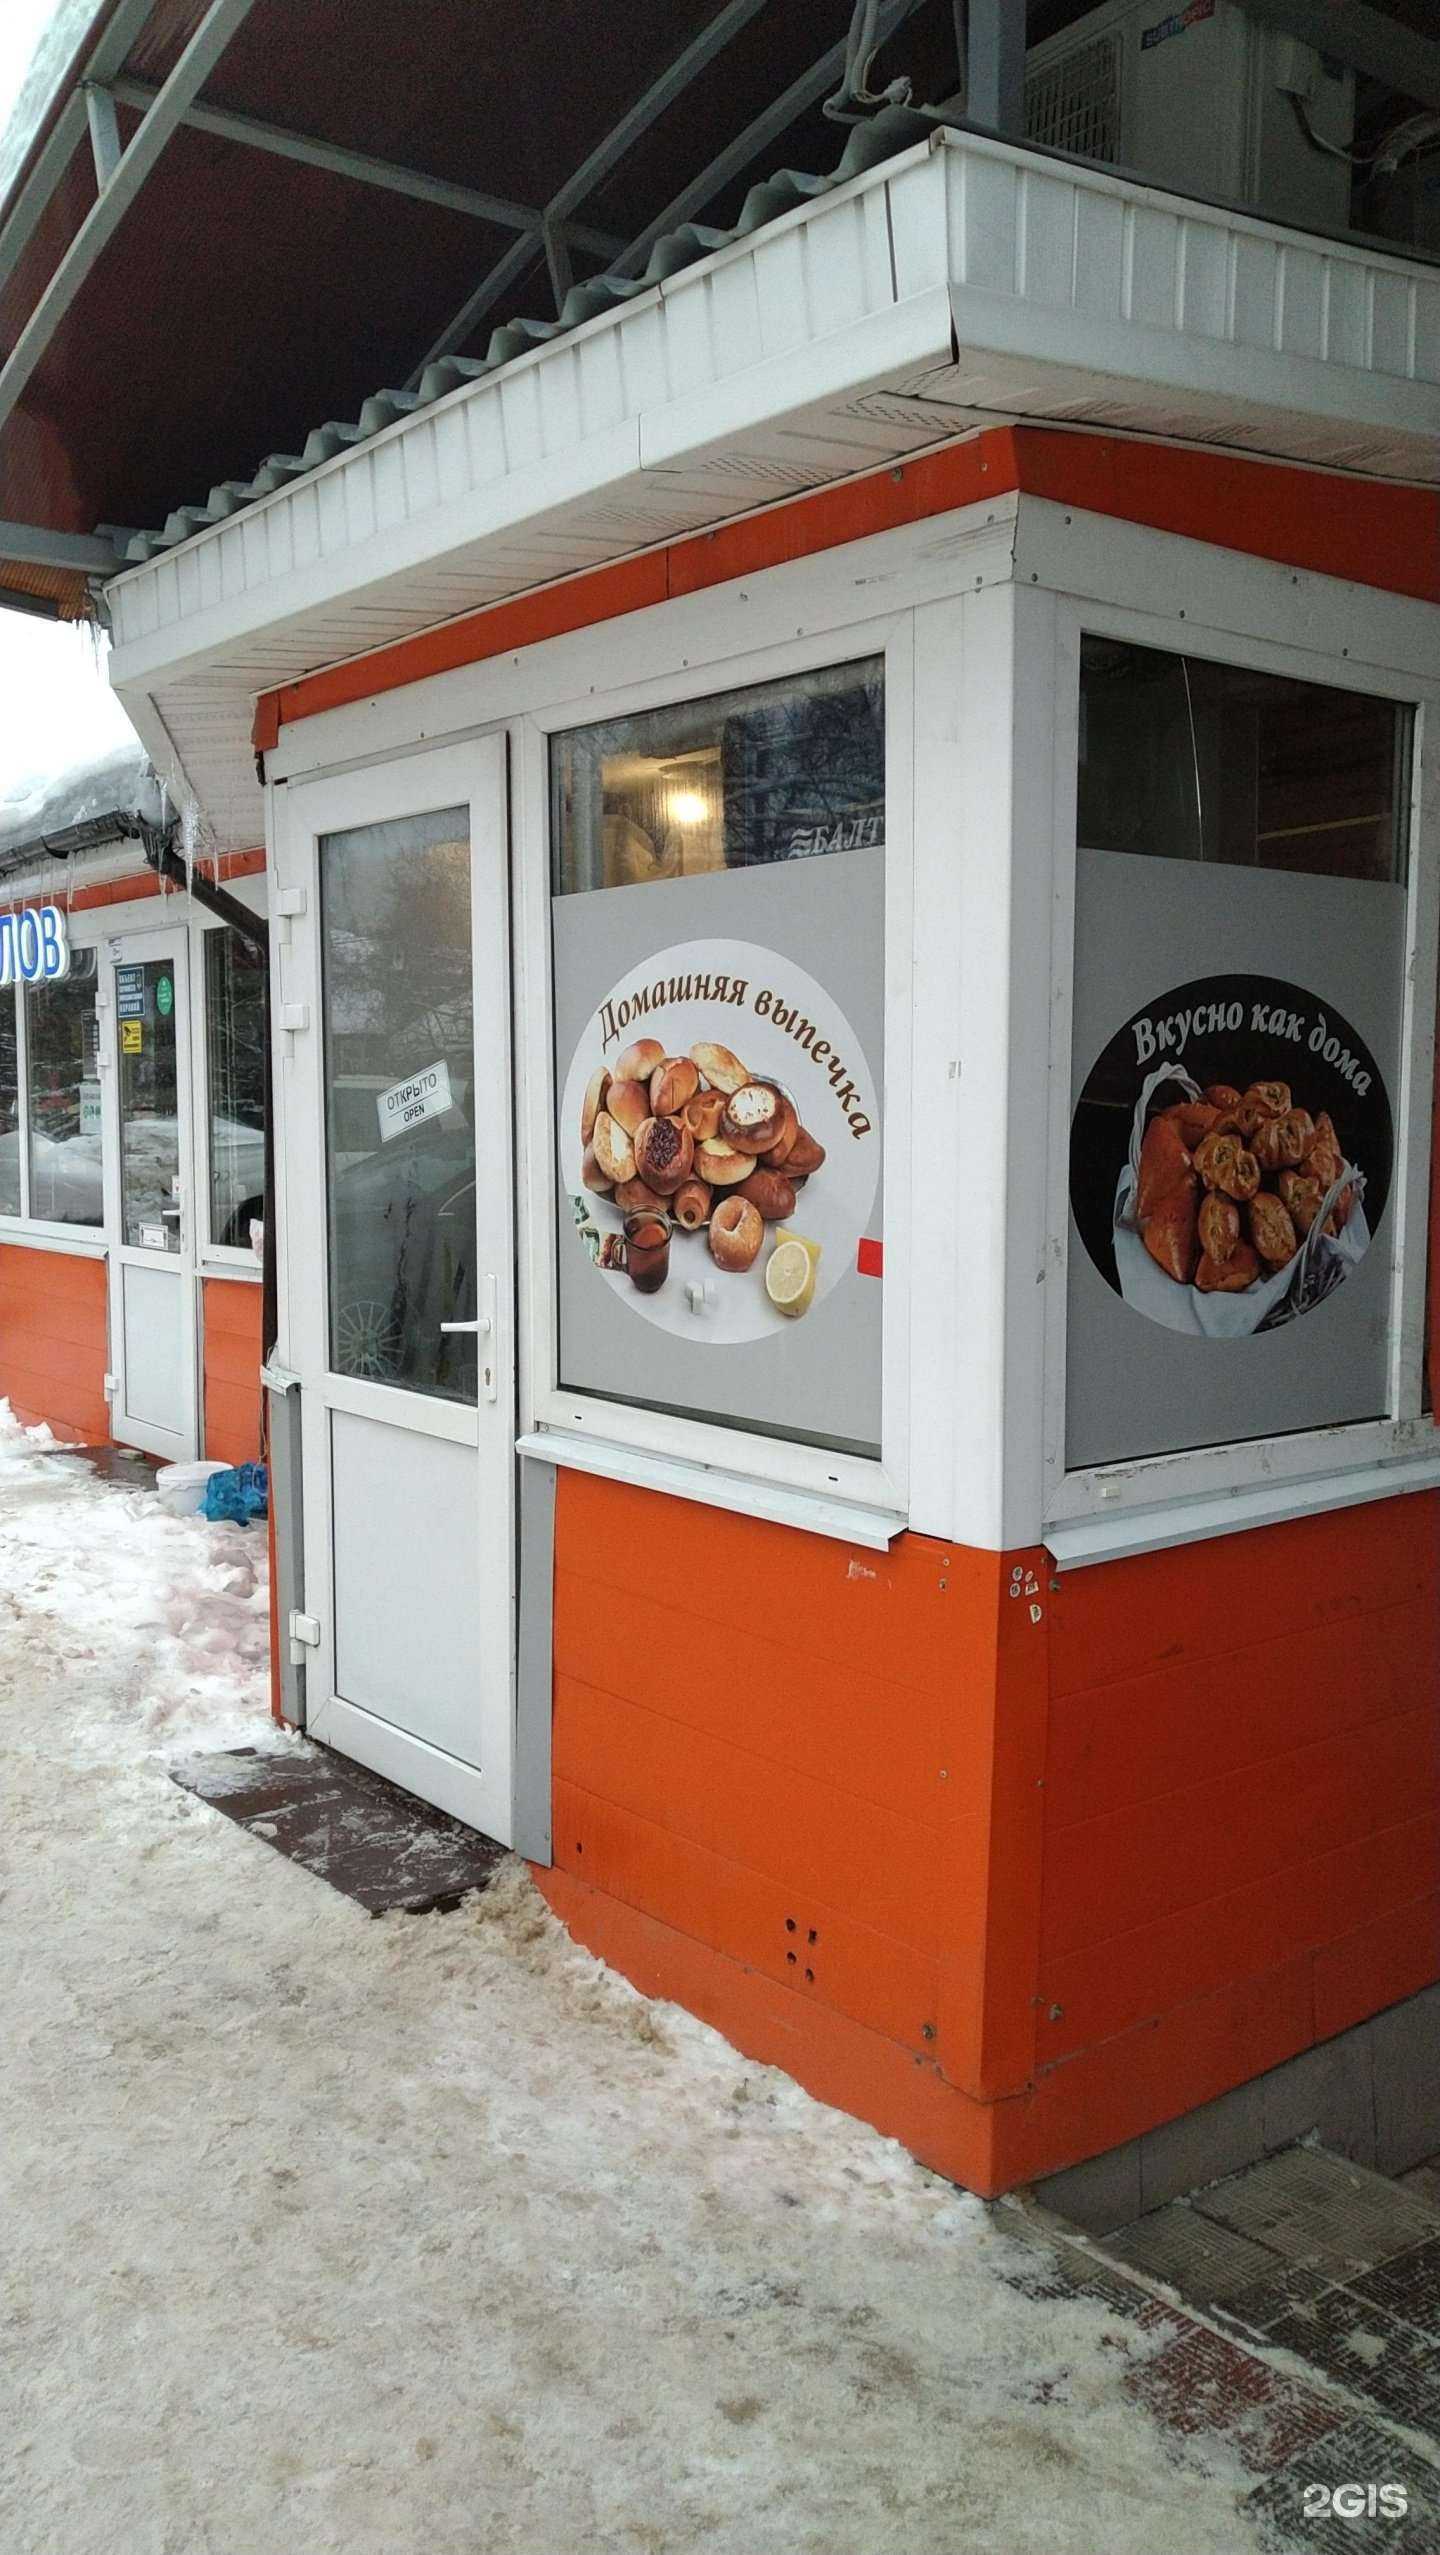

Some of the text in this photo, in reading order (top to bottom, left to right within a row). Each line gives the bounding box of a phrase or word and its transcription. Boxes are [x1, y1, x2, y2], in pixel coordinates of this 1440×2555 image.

[598, 973, 872, 1140] Домашняя выпечка
[1131, 1001, 1373, 1097] Вкусно как дома
[386, 1072, 438, 1111] ОТКРЫТО
[403, 1103, 425, 1122] OPEN
